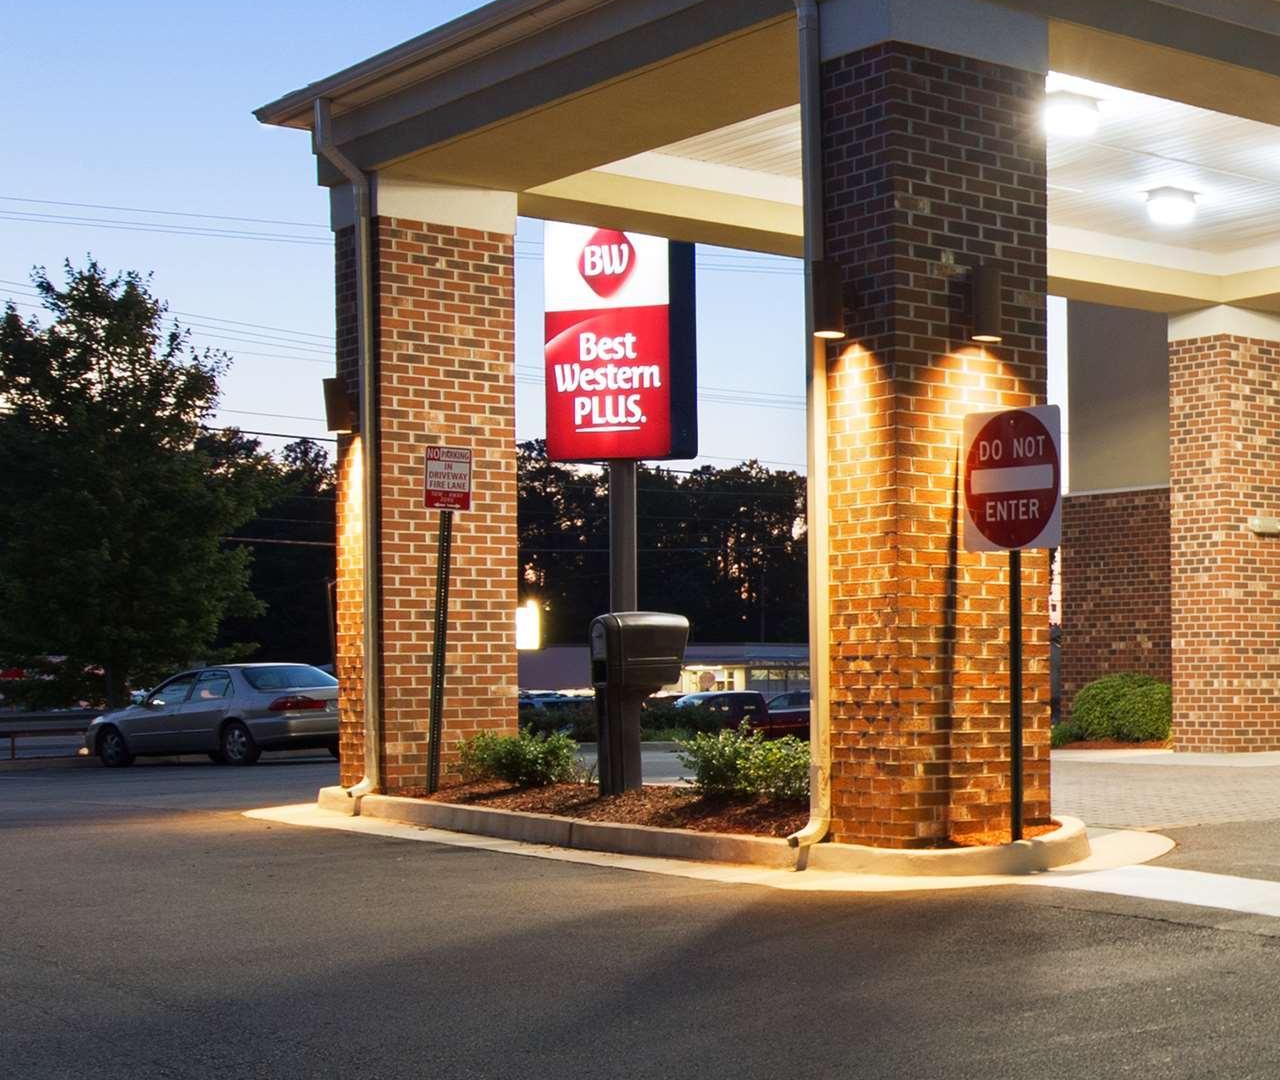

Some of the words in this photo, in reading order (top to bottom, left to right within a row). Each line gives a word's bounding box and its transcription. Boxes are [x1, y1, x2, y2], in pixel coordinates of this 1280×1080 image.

[584, 243, 629, 276] BW
[579, 332, 637, 361] Best
[554, 363, 662, 393] Western
[427, 447, 440, 459] NO
[979, 439, 1002, 461] DO
[1013, 435, 1046, 459] NOT
[429, 471, 468, 480] DRIVEWAY
[444, 462, 452, 470] IN
[429, 480, 446, 488] FIRE
[447, 481, 466, 489] LANE
[985, 499, 1040, 522] ENTER
